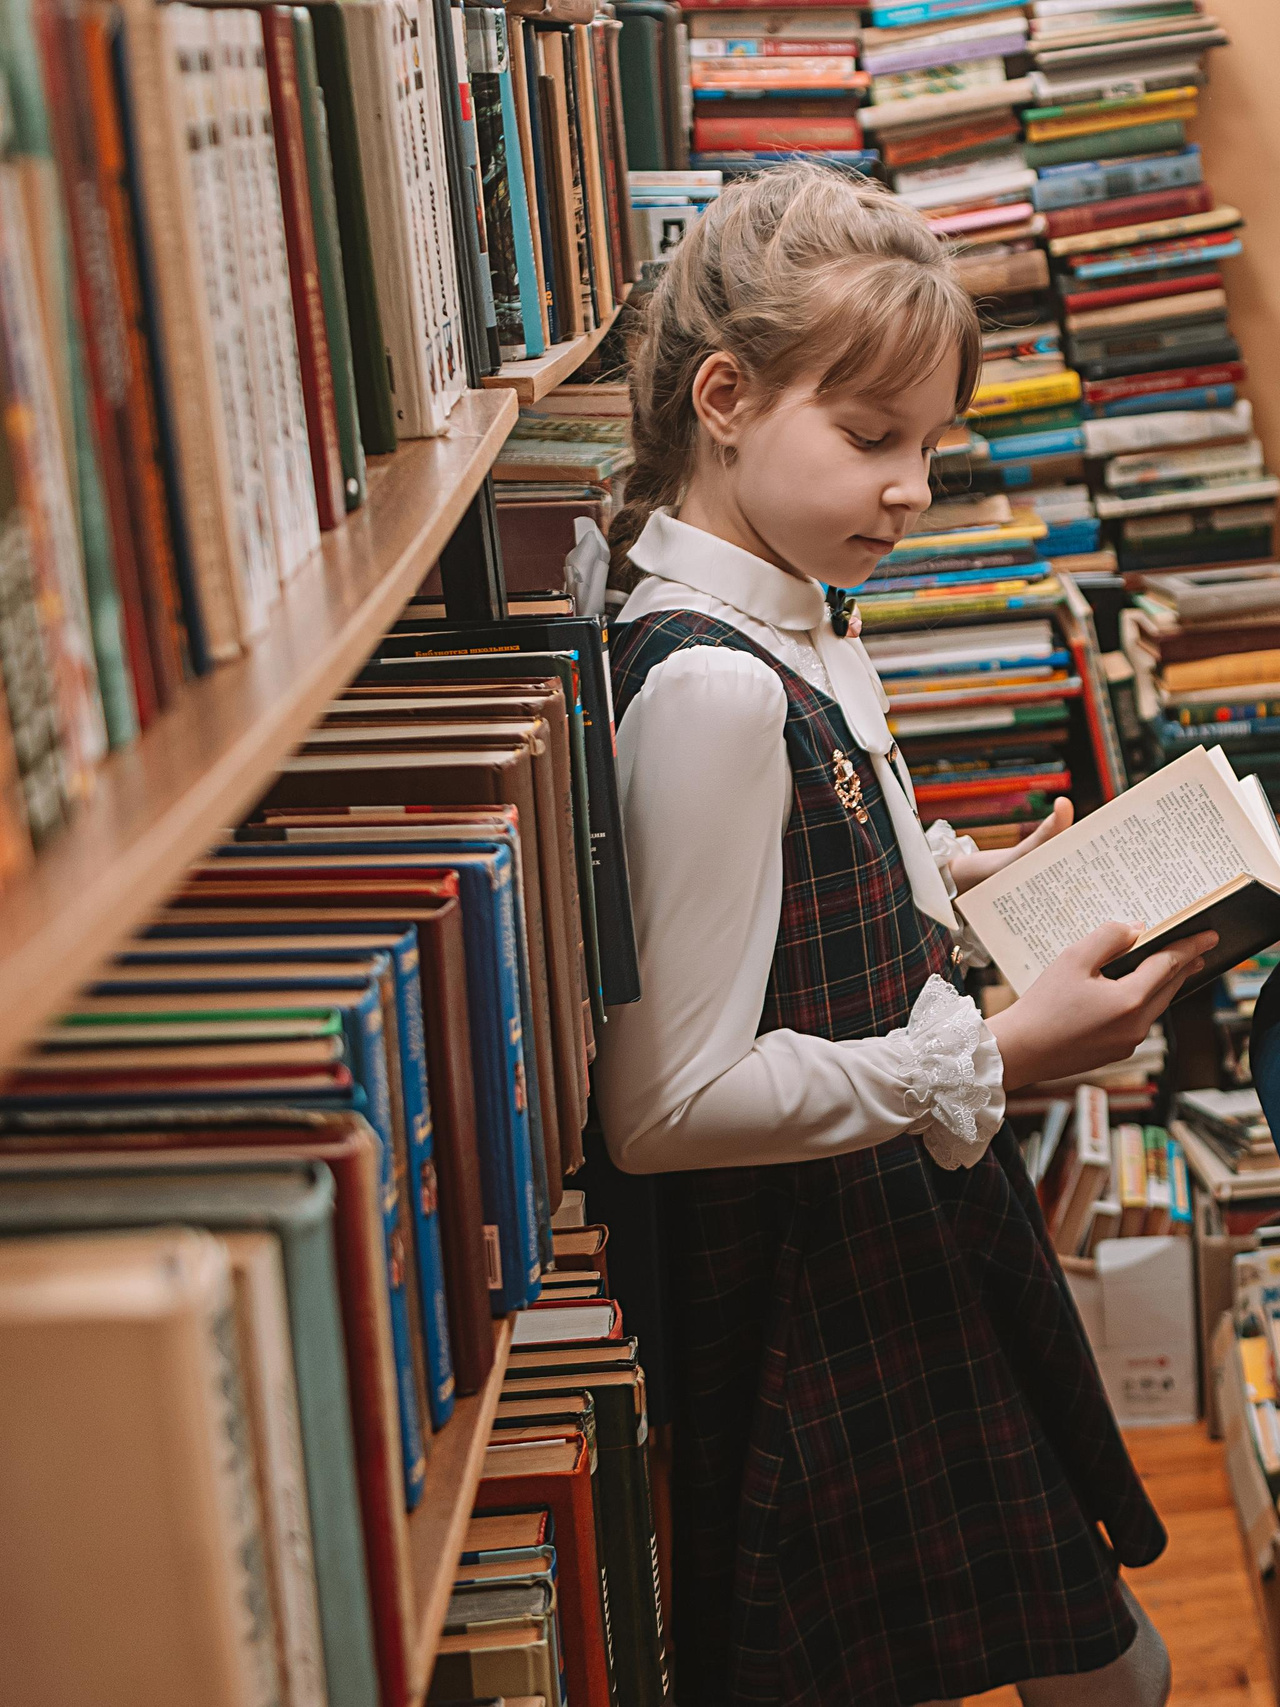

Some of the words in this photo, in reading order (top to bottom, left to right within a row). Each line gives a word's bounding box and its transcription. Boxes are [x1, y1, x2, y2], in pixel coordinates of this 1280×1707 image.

[416, 97, 431, 172] БЛОК
[428, 180, 448, 318] Александр
[470, 644, 520, 654] школьника
